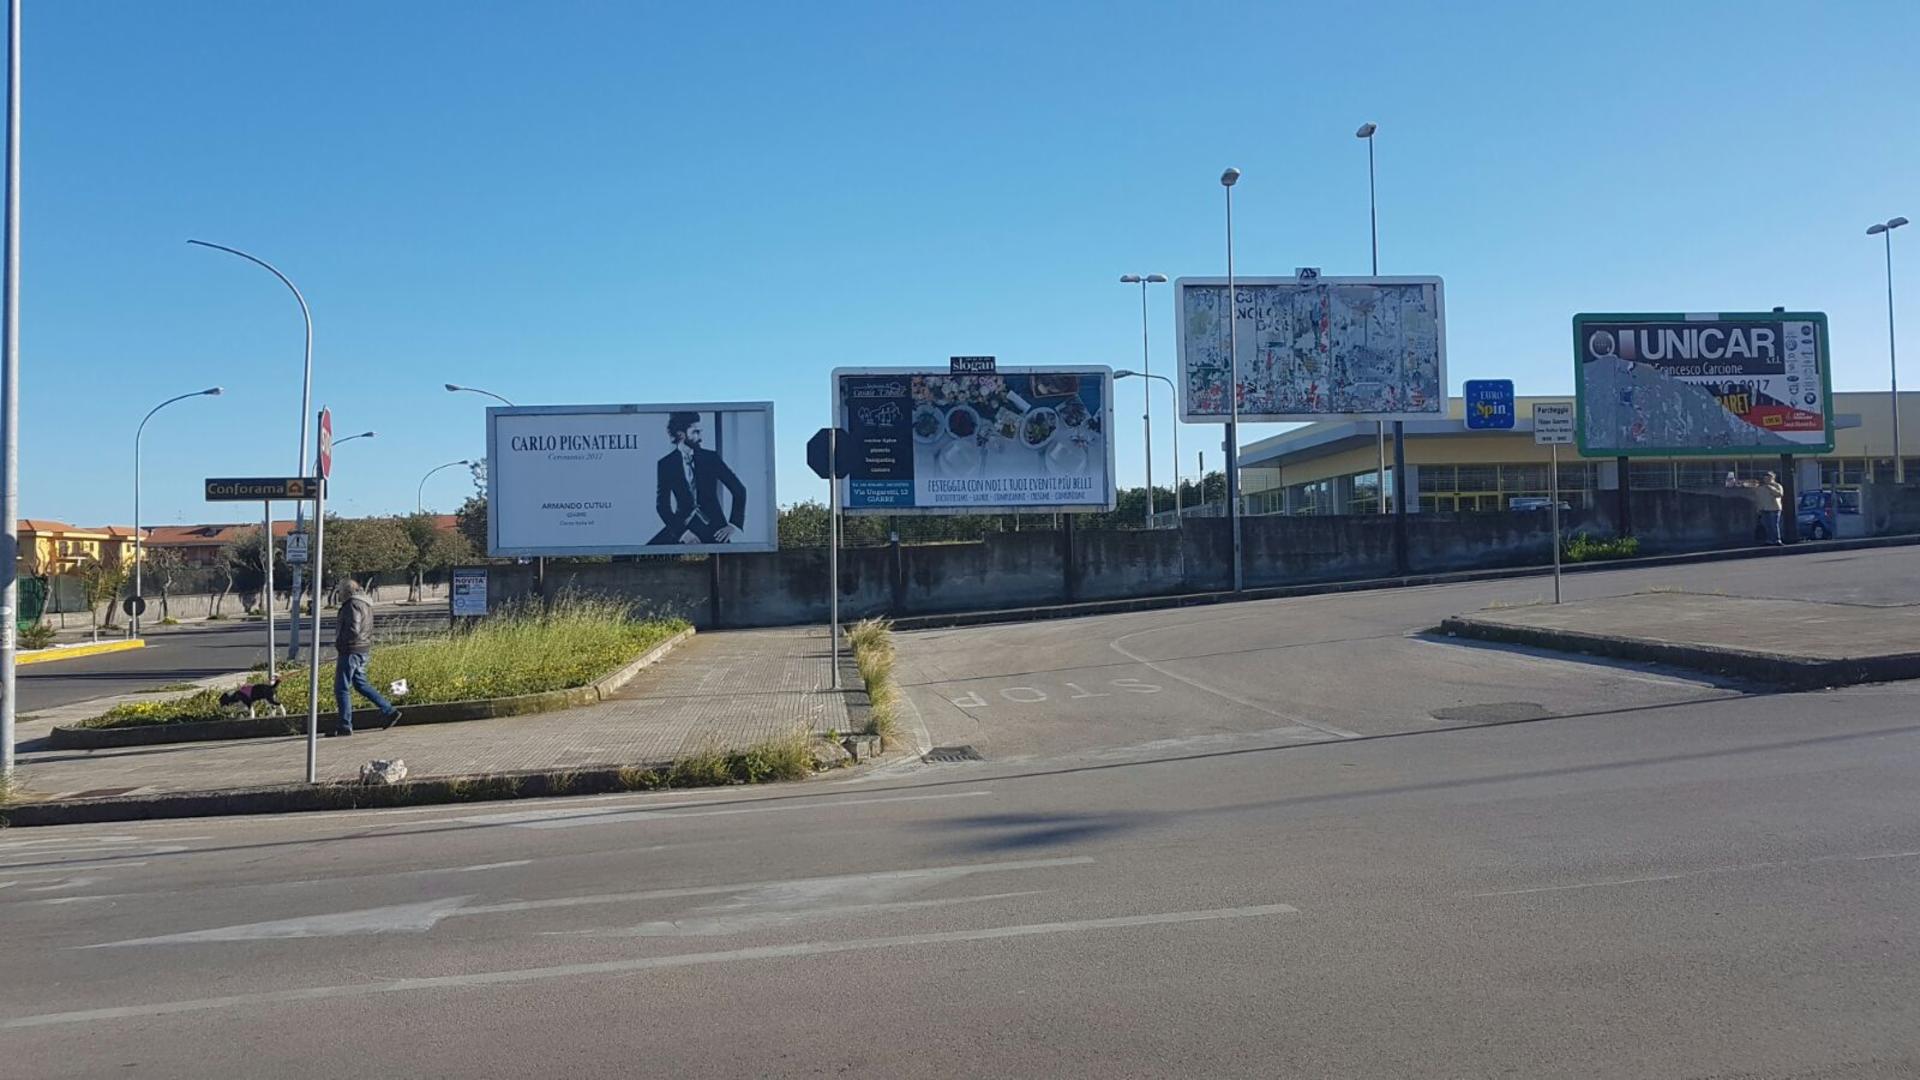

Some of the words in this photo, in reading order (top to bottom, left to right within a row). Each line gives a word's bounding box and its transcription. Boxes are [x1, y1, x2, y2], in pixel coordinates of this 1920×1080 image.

[1640, 327, 1776, 360] UNICAR
[953, 358, 994, 373] slogan
[1702, 362, 1743, 375] Carcione
[1480, 390, 1503, 400] EURO
[1476, 401, 1506, 418] Spin
[511, 435, 557, 452] CARLO
[560, 434, 638, 451] PIGNATELLI
[207, 482, 285, 496] Conforama
[928, 479, 966, 492] FESTEGGIA
[967, 479, 985, 492] CON
[985, 479, 1002, 491] NOI
[1009, 478, 1028, 491] TUOI
[1029, 478, 1057, 491] EVENTI
[1072, 477, 1092, 489] BELLI
[542, 502, 583, 510] ARMANDO
[583, 501, 612, 509] CUTULI
[951, 678, 1162, 708] STOP
